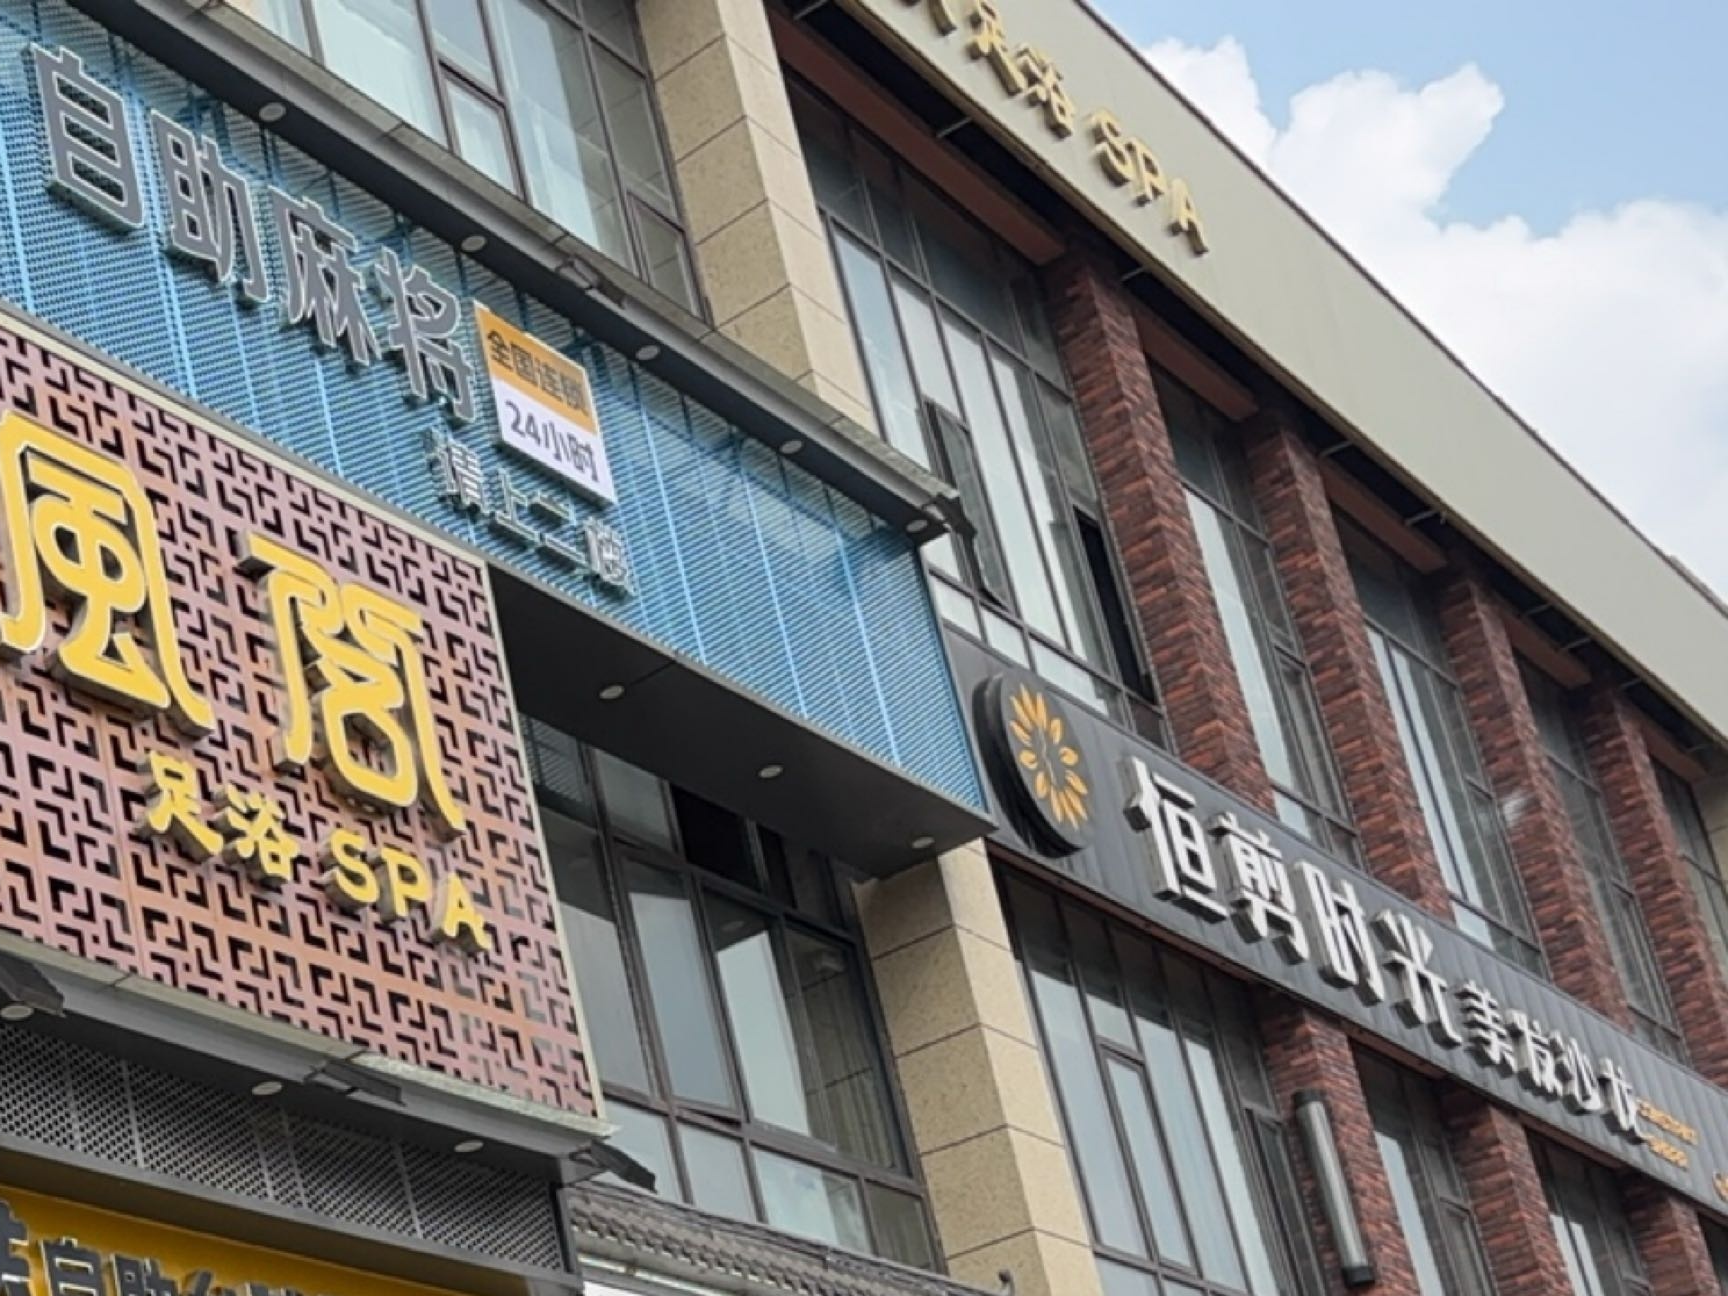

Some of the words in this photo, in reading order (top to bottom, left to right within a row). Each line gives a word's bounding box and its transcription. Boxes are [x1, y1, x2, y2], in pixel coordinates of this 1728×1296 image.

[31, 44, 475, 425] 自助麻将
[1085, 106, 1208, 254] SPA
[423, 425, 635, 598] 请上二楼
[503, 400, 600, 484] 24小时
[146, 753, 300, 884] 足浴
[322, 829, 490, 951] SPA
[1122, 754, 1464, 1048] 恒剪时光
